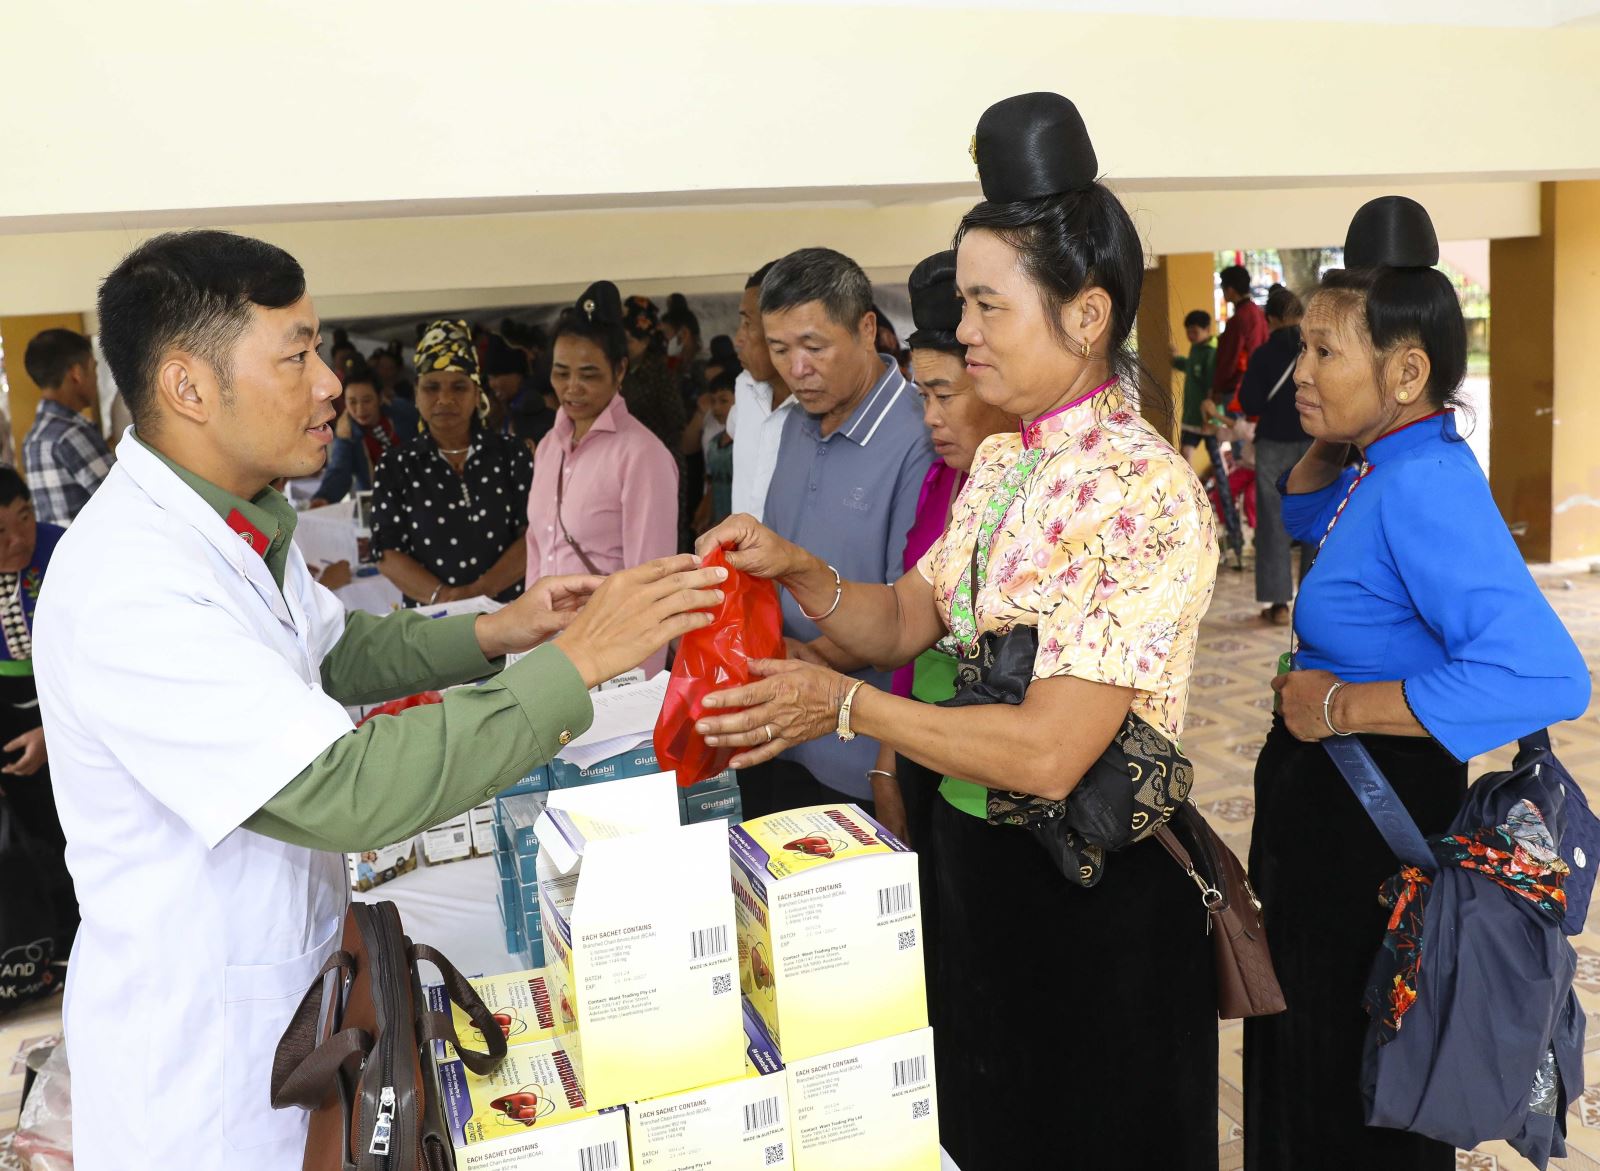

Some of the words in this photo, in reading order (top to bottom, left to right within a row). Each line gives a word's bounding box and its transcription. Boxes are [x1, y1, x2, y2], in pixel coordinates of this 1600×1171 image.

[634, 756, 658, 766] Gluta
[580, 764, 614, 778] Glutabil
[701, 797, 734, 810] Glutabil
[778, 892, 792, 901] EACH
[794, 889, 814, 898] SACHET
[816, 883, 842, 893] CONTAINS
[582, 933, 597, 941] EACH
[599, 929, 621, 938] SACHET
[623, 924, 652, 934] CONTAINS
[796, 1068, 810, 1076] EACH
[811, 1064, 831, 1073] SACHET
[832, 1057, 858, 1068] CONTAINS
[639, 1110, 654, 1119] EACH
[656, 1106, 677, 1116] SACHET
[679, 1099, 706, 1111] CONTAINS
[467, 1154, 483, 1164] EACH
[484, 1150, 508, 1160] SACHET
[509, 1143, 539, 1155] CONTAINS
